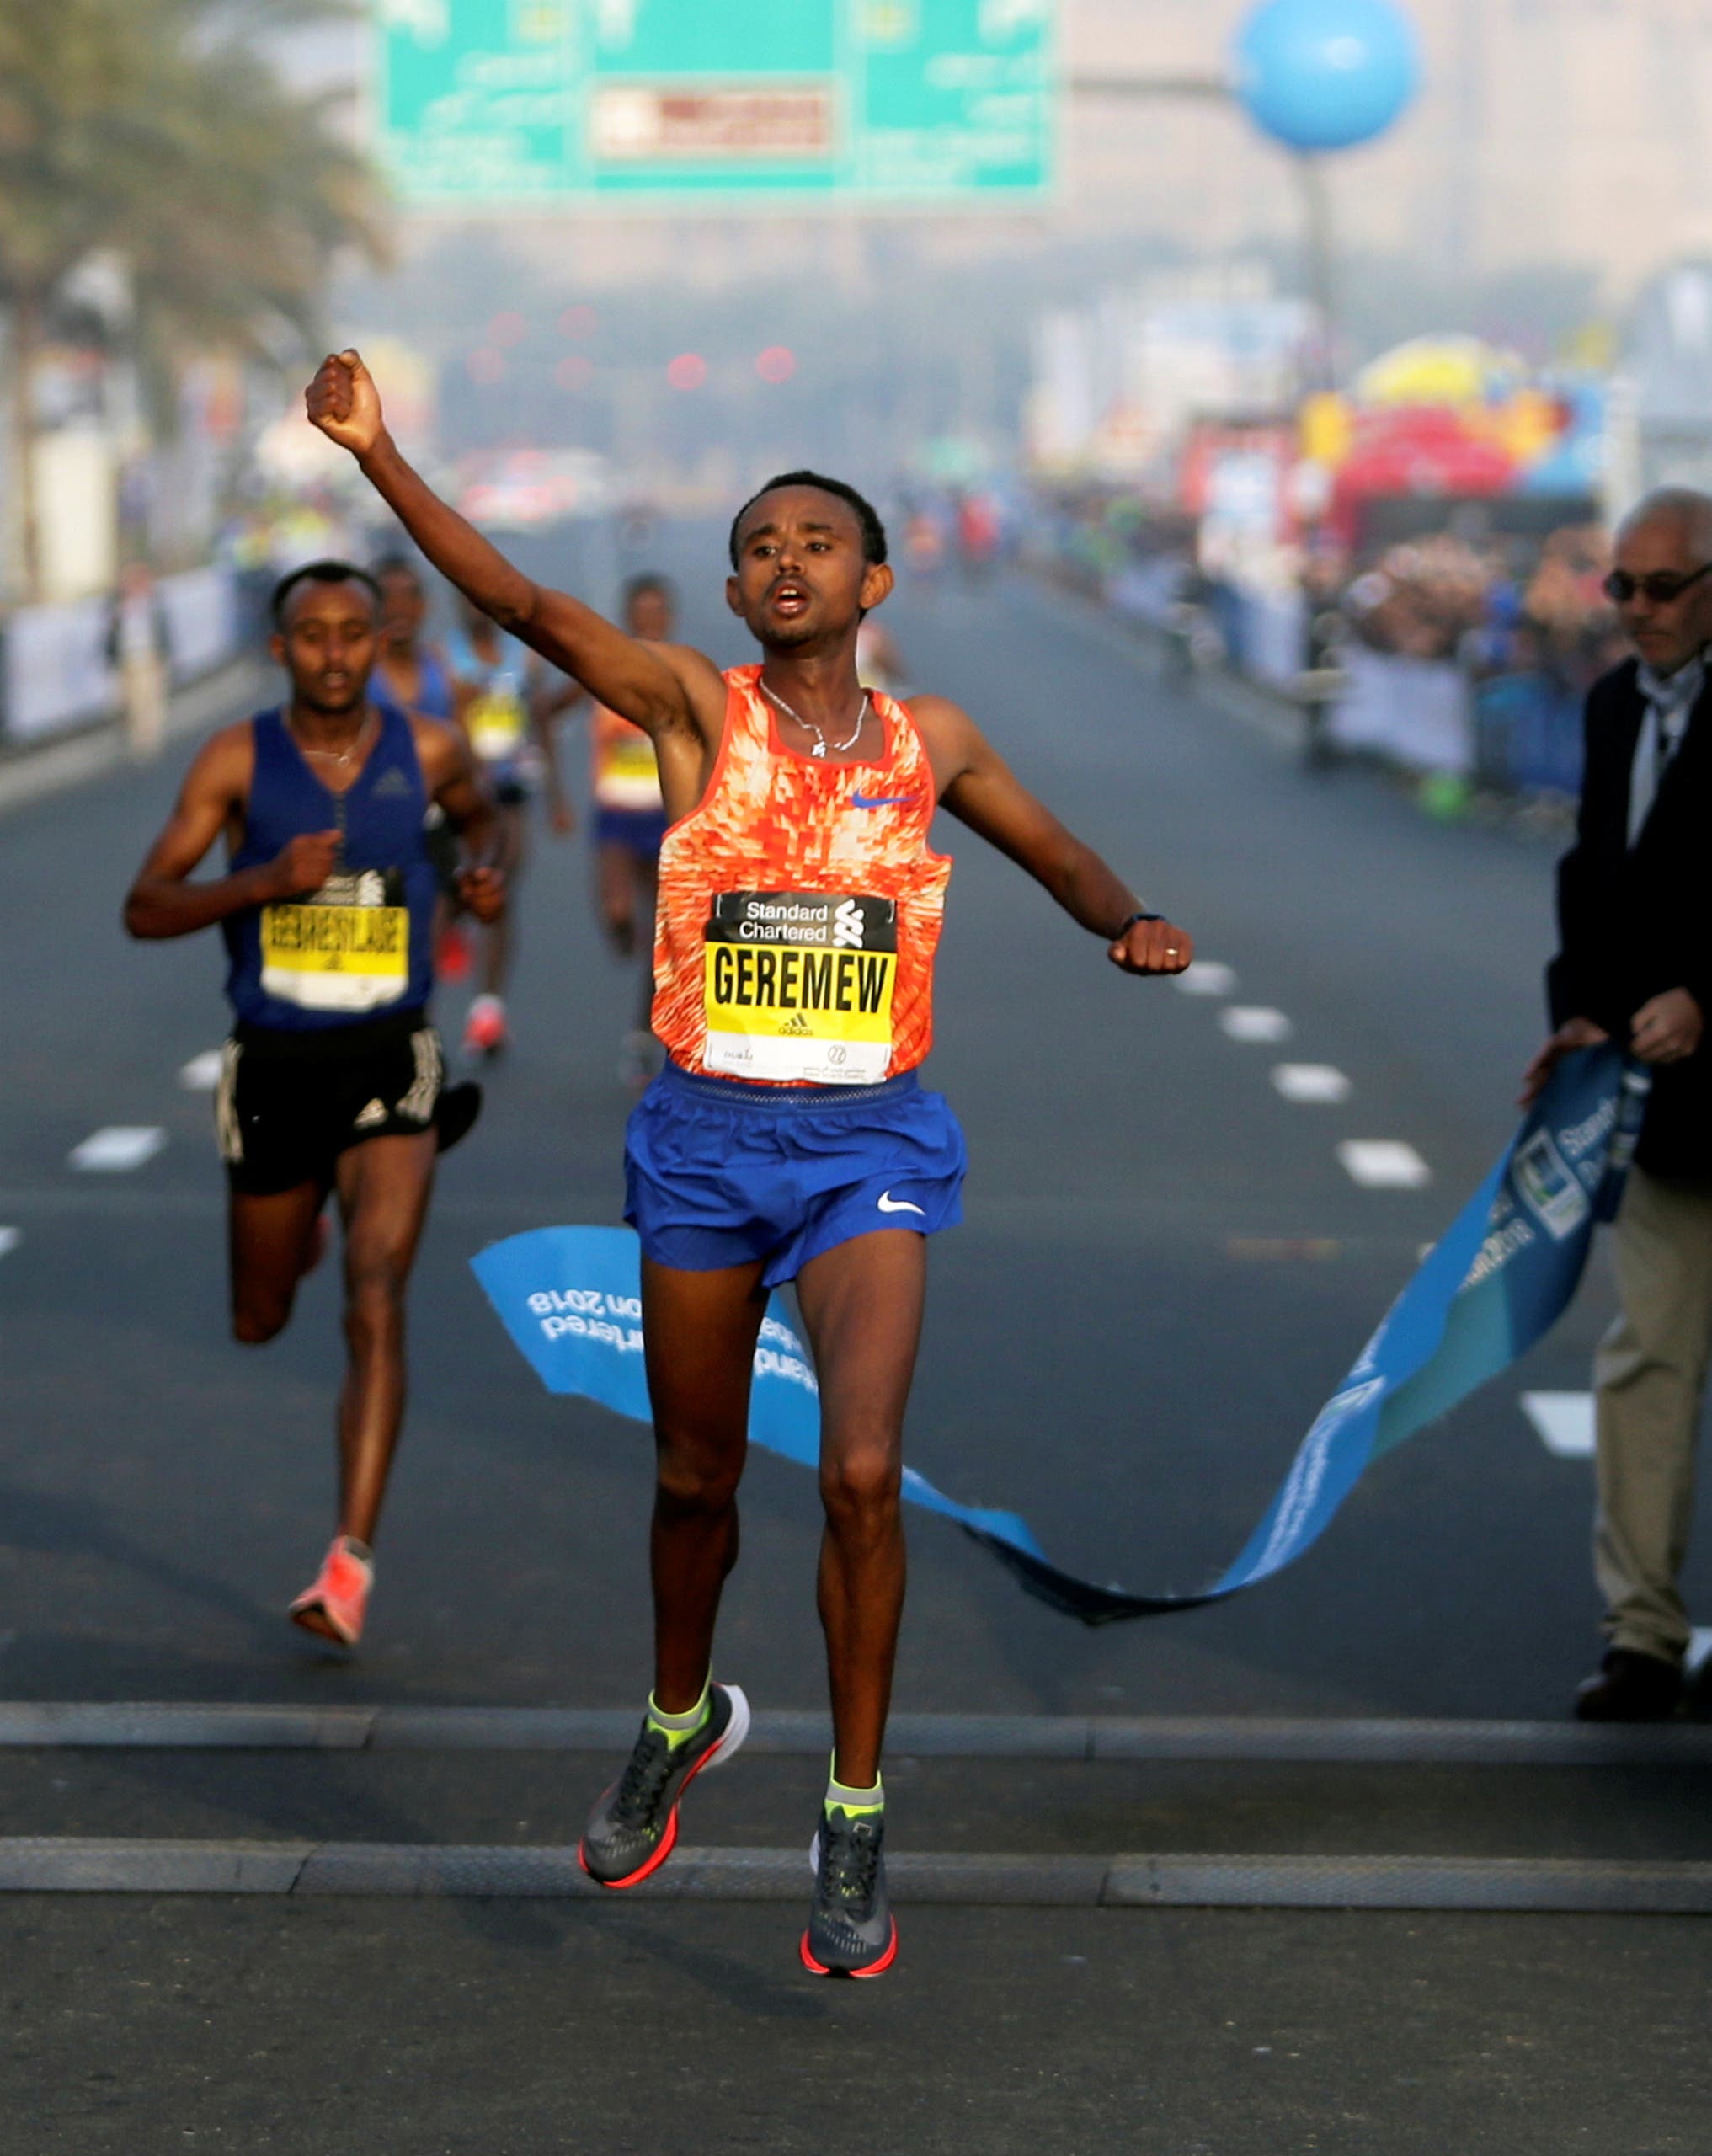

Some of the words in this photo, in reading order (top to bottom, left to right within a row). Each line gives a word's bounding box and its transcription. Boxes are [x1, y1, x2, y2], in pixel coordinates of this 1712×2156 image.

[746, 901, 828, 922] Standard
[739, 923, 827, 942] Chartered
[714, 946, 888, 1014] GEREMEW
[778, 1026, 813, 1037] adidas
[526, 1289, 605, 1317] 2018
